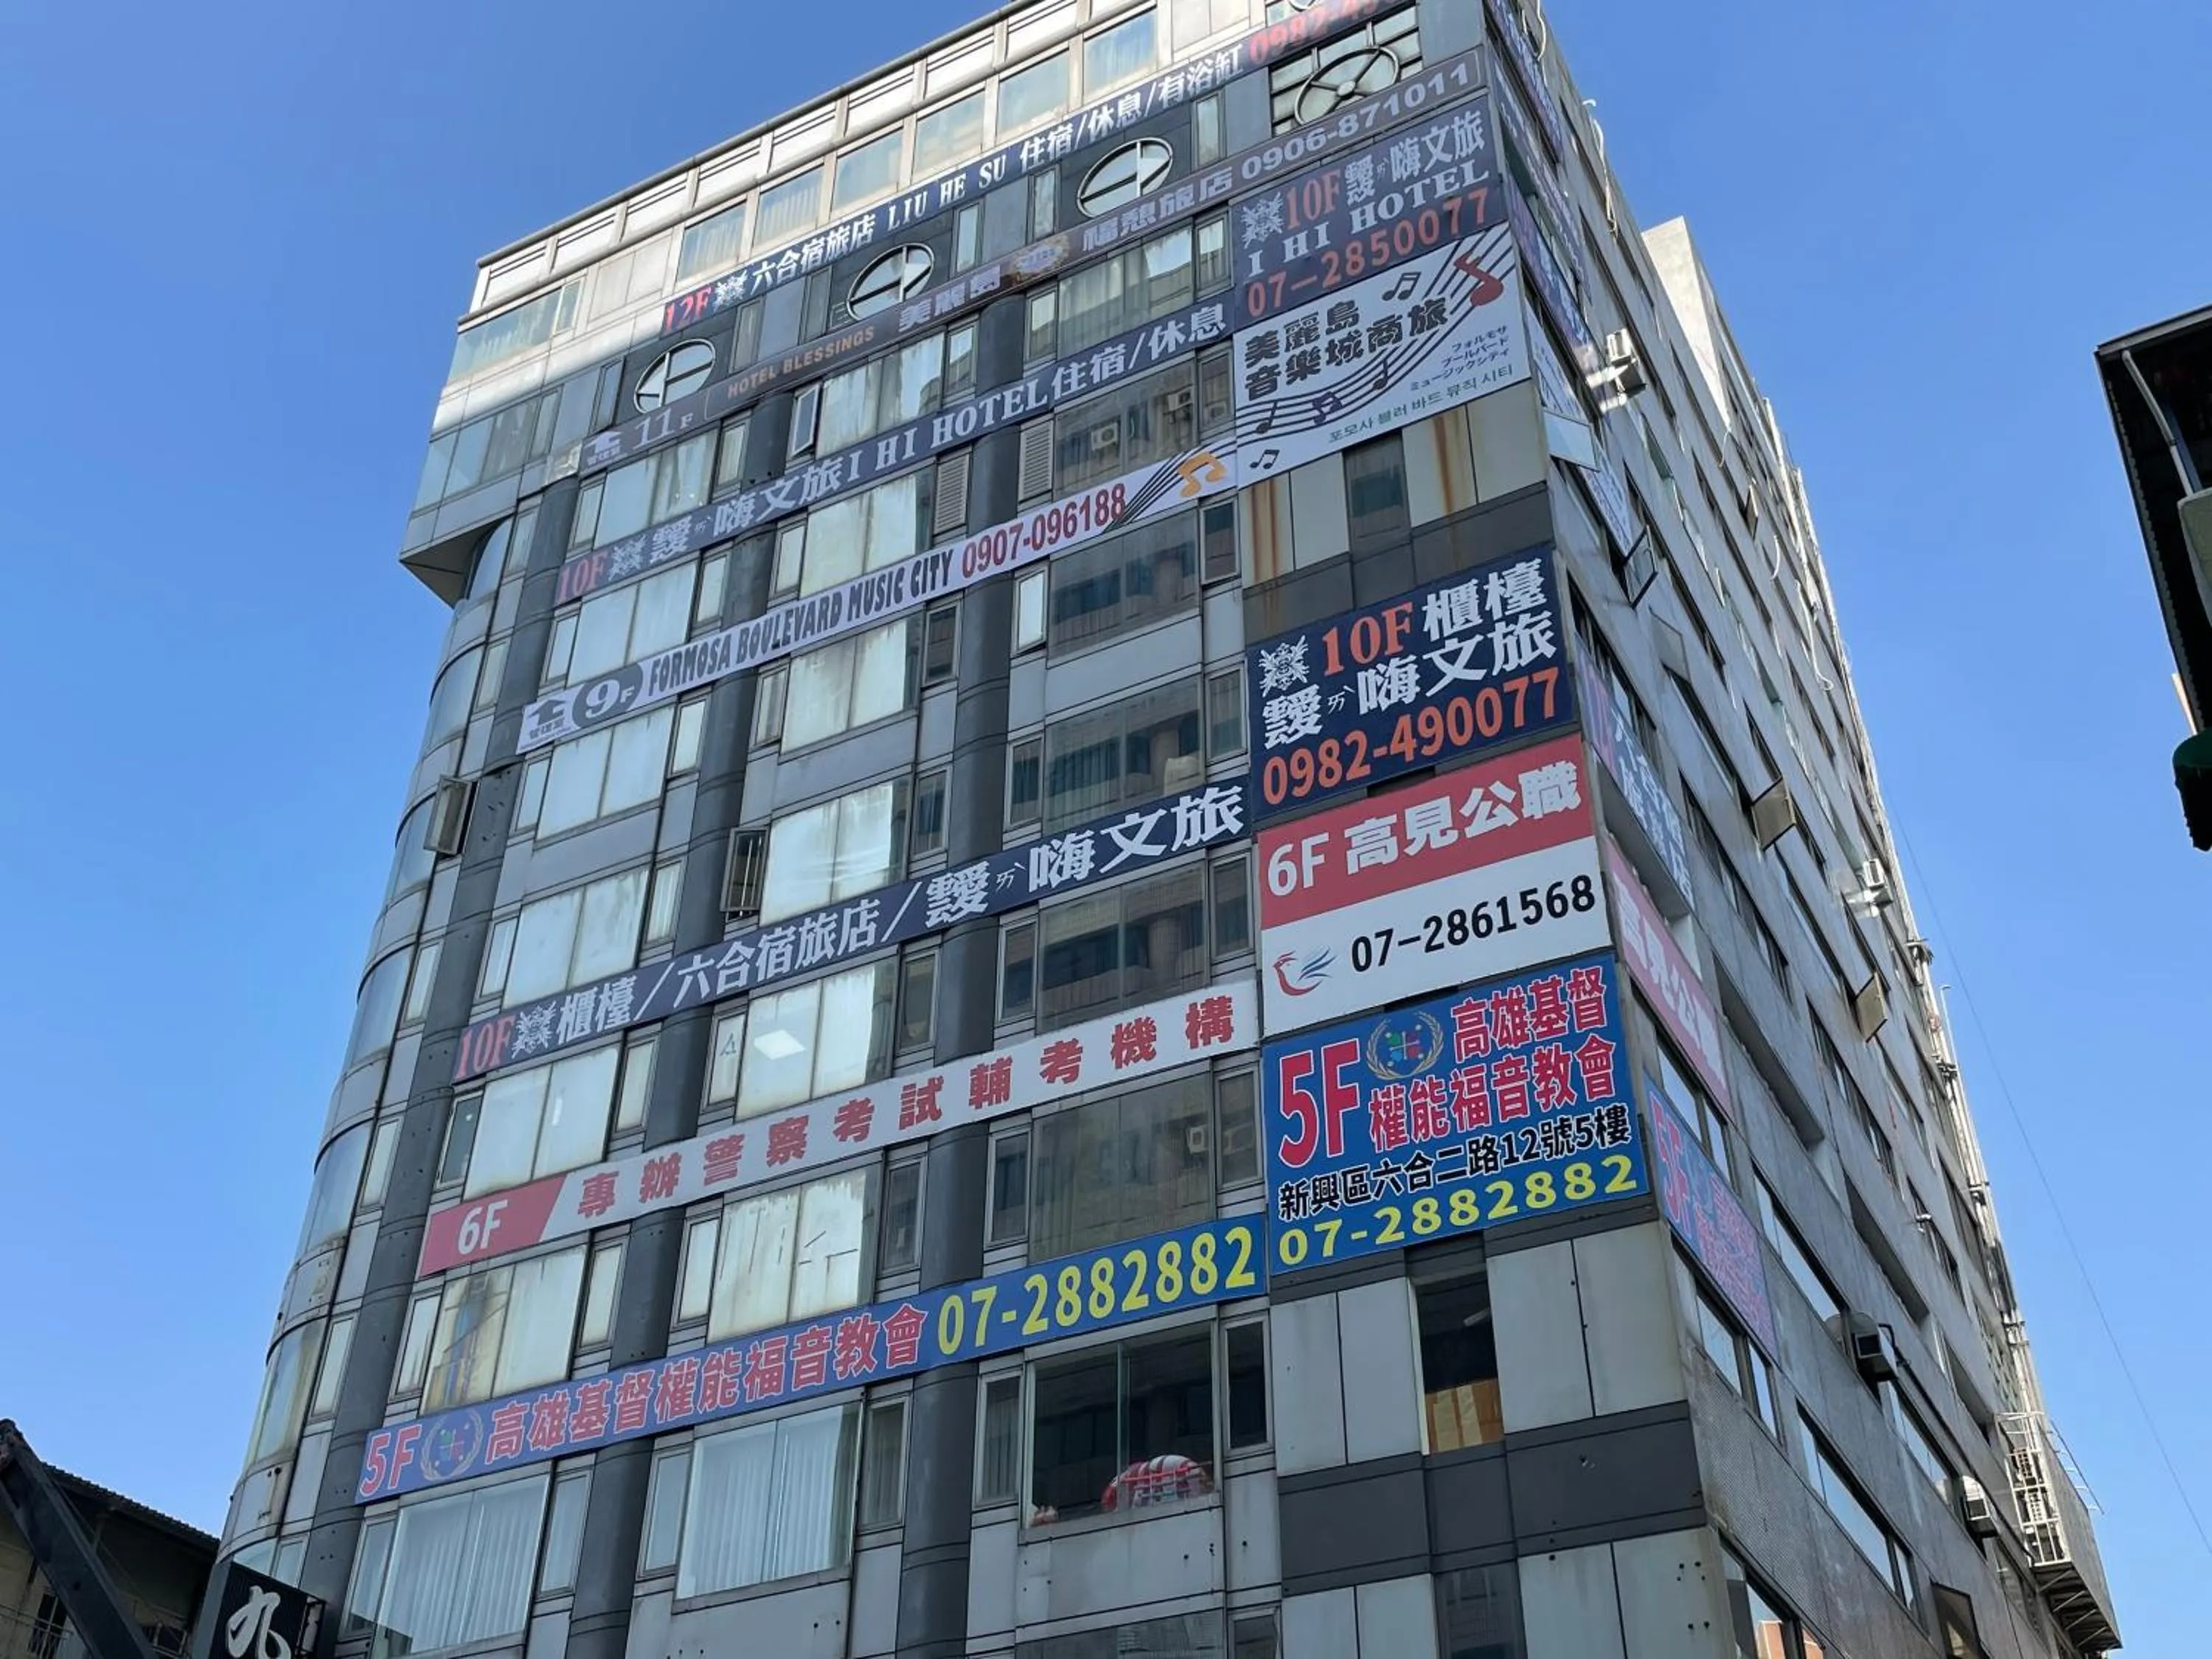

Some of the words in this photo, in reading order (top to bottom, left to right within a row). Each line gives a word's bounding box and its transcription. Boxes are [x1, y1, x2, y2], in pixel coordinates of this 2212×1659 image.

[665, 283, 711, 333] 12F
[751, 214, 876, 295] 六合宿旅店
[888, 189, 928, 231] LIU
[939, 173, 966, 208] HE
[978, 154, 1006, 189] SU
[727, 367, 777, 399] HOTEL
[782, 327, 875, 373] BLESSINGS
[1242, 63, 1469, 180] 0906-871011
[1248, 249, 1265, 278] I
[1282, 222, 1332, 263] HI
[1349, 159, 1489, 234] HOTEL
[1248, 186, 1489, 317] 07-2850077
[1286, 169, 1341, 230] 10F
[1245, 300, 1360, 369] 美麗島
[1245, 297, 1448, 401] 音樂城商旅
[557, 550, 609, 605] 10F
[874, 428, 919, 472] HI
[932, 377, 1048, 447] HOTEL
[1051, 302, 1227, 400] 住宿/休息
[1329, 416, 1373, 443] 포모사
[1481, 364, 1513, 384] 시티
[647, 632, 731, 698] FORMOSA
[736, 591, 844, 664] BOULEVARD
[847, 567, 904, 623] MUSIC
[910, 548, 954, 598] CITY
[961, 482, 1127, 580] 0907-096188
[1322, 601, 1414, 677] 10F
[1423, 557, 1548, 642] 櫃檯
[1262, 667, 1559, 806] 0982-490077
[1267, 832, 1329, 898] 6F
[1343, 759, 1583, 876] 高見公職
[1351, 874, 1596, 974] 07-2861568
[455, 1015, 516, 1080] 10F
[1450, 964, 1608, 1064] 高雄基督
[457, 1199, 510, 1256] 6F
[575, 995, 1235, 1221] 專辦警察考試輔考機構
[1277, 1037, 1362, 1169] 5F
[1367, 1033, 1618, 1156] 權能福音教會
[1278, 1102, 1632, 1224] 新興區六合二路12號5樓
[1279, 1152, 1639, 1267] 07-2882882
[359, 1423, 422, 1499] 5F
[484, 1301, 930, 1467] 高雄基督權能福音教會
[937, 1225, 1256, 1357] 07-2882882
